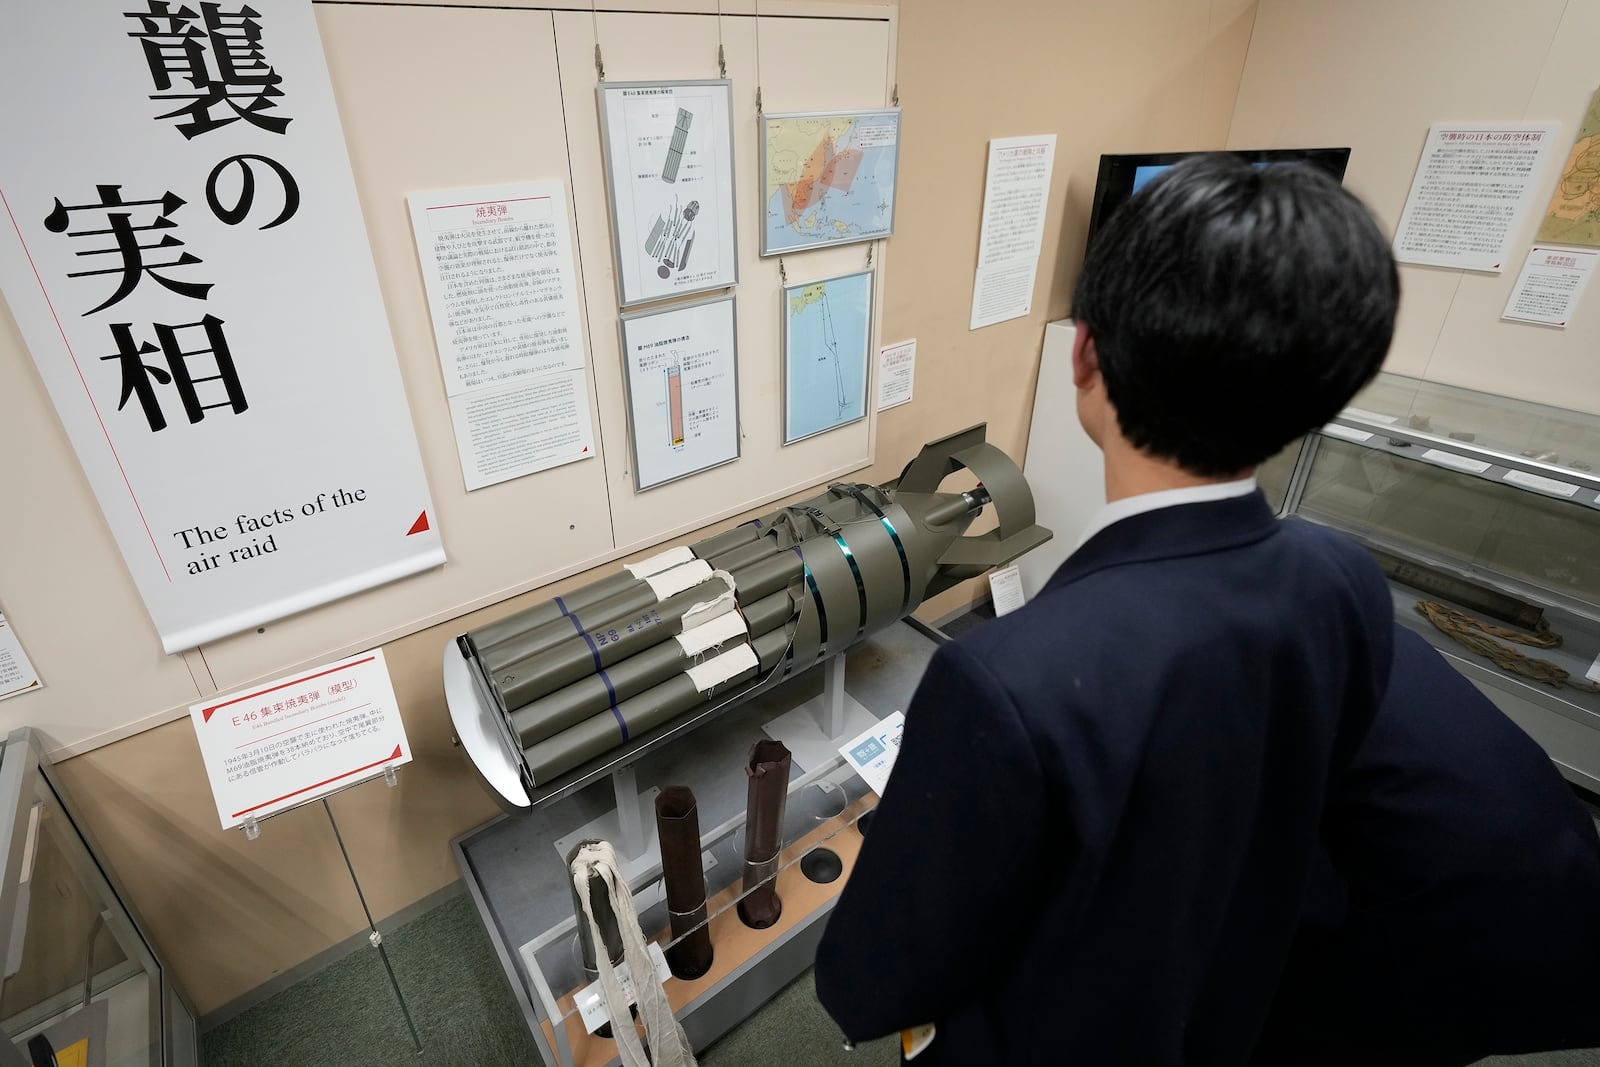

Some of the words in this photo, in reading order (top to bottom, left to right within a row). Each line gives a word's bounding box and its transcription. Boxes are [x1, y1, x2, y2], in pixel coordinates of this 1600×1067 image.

[124, 0, 300, 231] 襲の
[1439, 133, 1542, 141] 空襲時の日本の防空体制
[475, 204, 508, 218] 焼夷弾
[44, 184, 250, 433] 実相
[173, 525, 228, 551] The
[235, 508, 294, 535] facts
[301, 493, 327, 516] of
[331, 487, 367, 508] the
[187, 550, 221, 576] air
[228, 536, 279, 564] raid
[596, 632, 608, 646] NP
[608, 629, 619, 641] 69
[231, 716, 240, 727] E
[242, 710, 258, 723] 46
[259, 689, 321, 718] 集束焼夷弾
[283, 706, 309, 720] Incendiary
